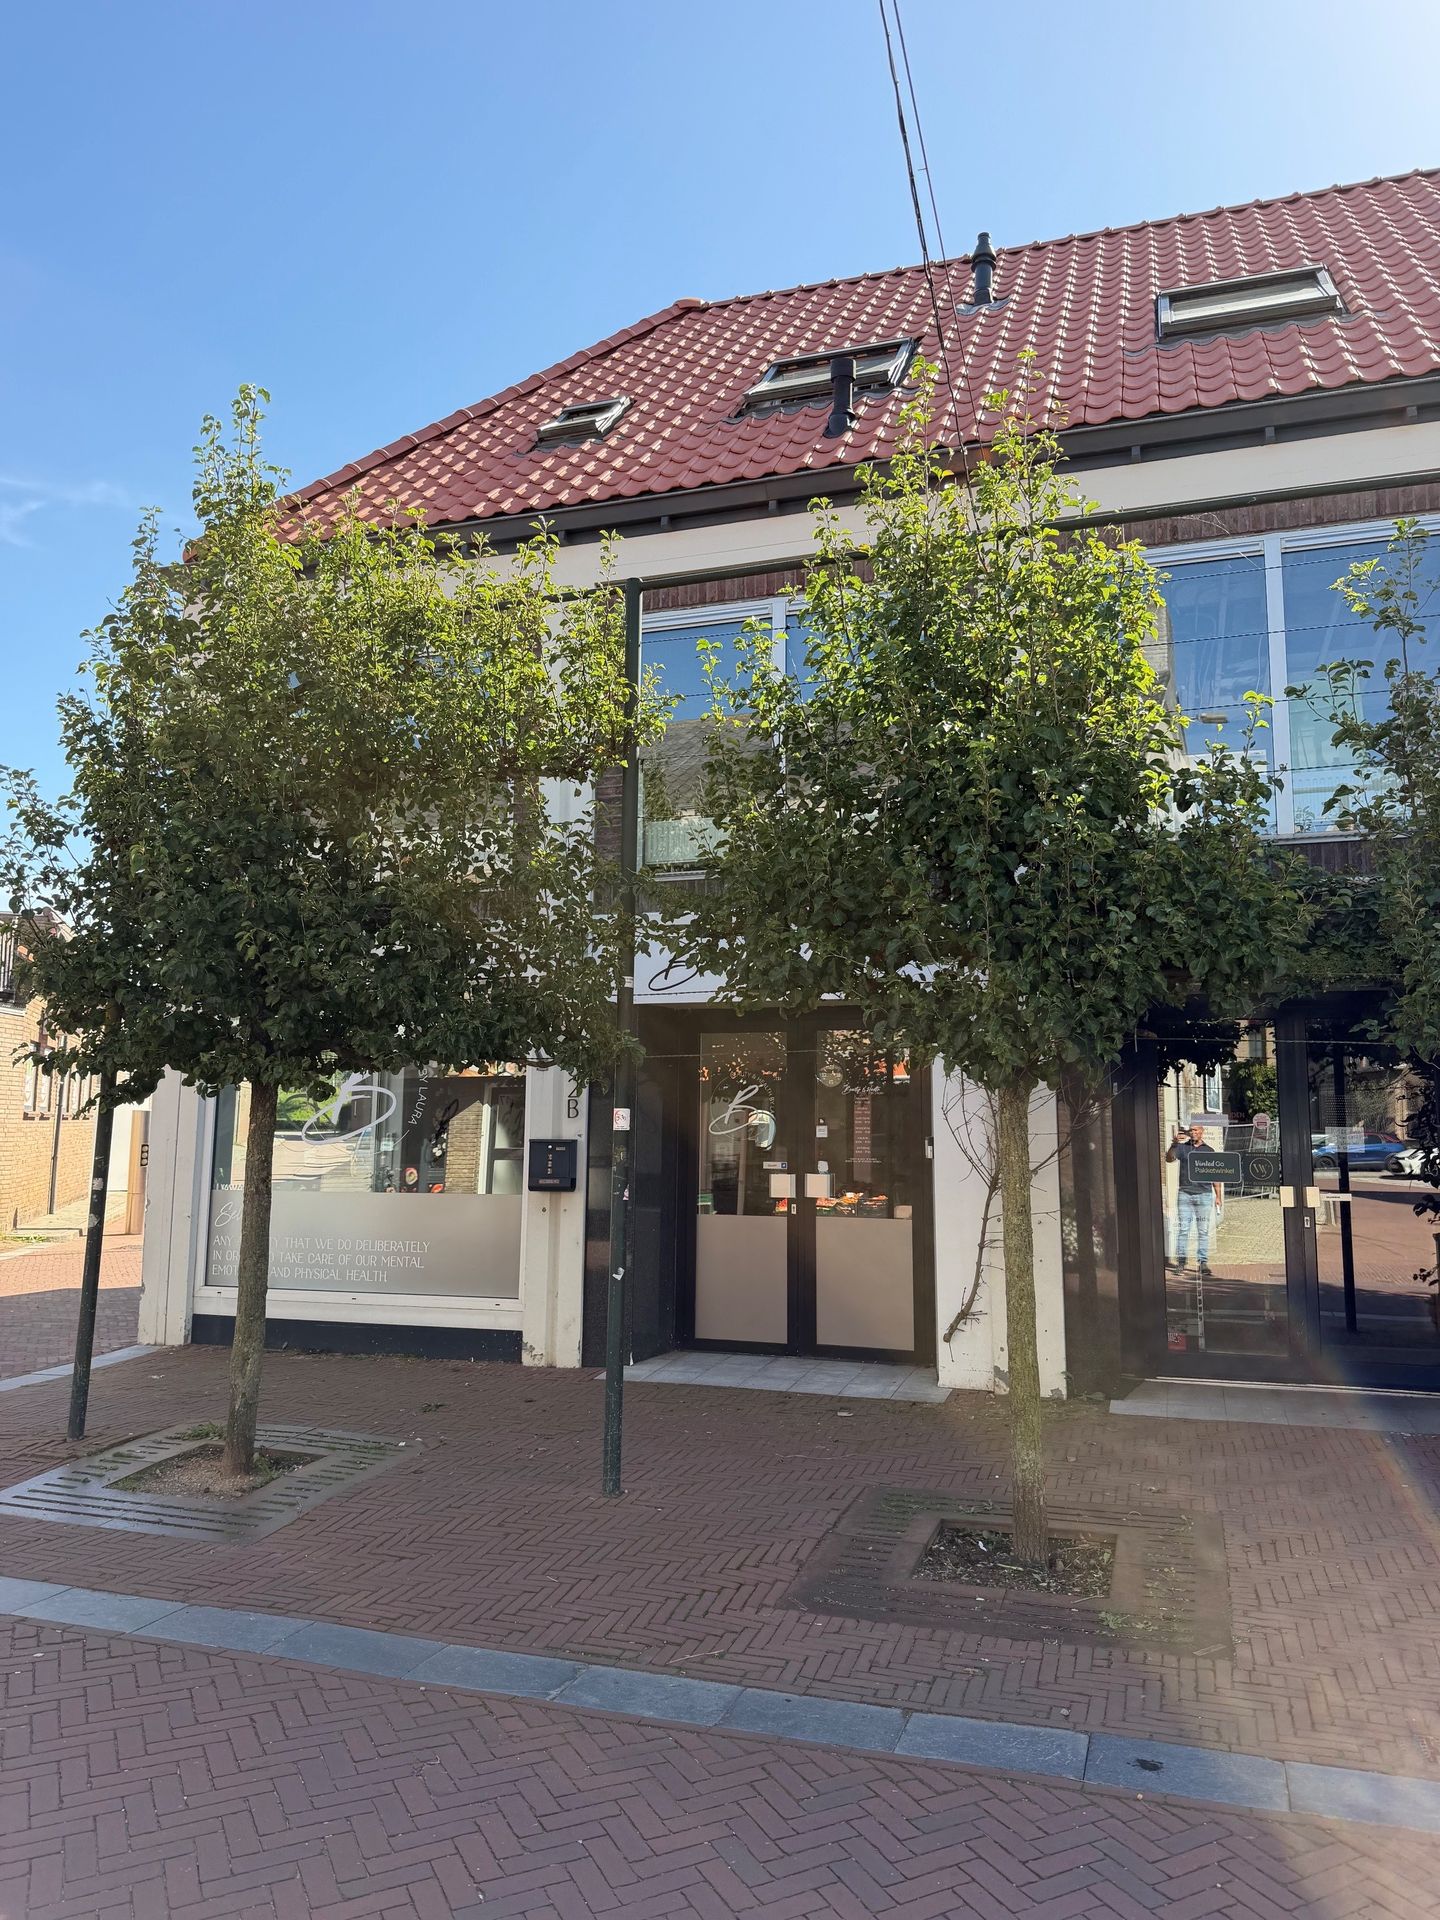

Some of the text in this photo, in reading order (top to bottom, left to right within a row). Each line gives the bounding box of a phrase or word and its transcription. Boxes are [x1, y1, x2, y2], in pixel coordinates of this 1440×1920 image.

[408, 1067, 429, 1125] BY LAURA
[567, 1098, 579, 1119] B
[1194, 1167, 1235, 1175] Pakketwinkel
[213, 1235, 233, 1247] ANY
[283, 1237, 311, 1249] THAT
[314, 1238, 334, 1250] WE
[337, 1239, 352, 1251] DO
[355, 1239, 431, 1253] DELIBERATELY
[212, 1250, 222, 1261] IN
[279, 1252, 304, 1264] TAKE
[307, 1252, 335, 1265] CARE
[338, 1253, 352, 1265] OF
[355, 1254, 377, 1267] OUR
[380, 1255, 425, 1269] MENTAL
[270, 1267, 388, 1283] AND PHYSICAL HEALTH
